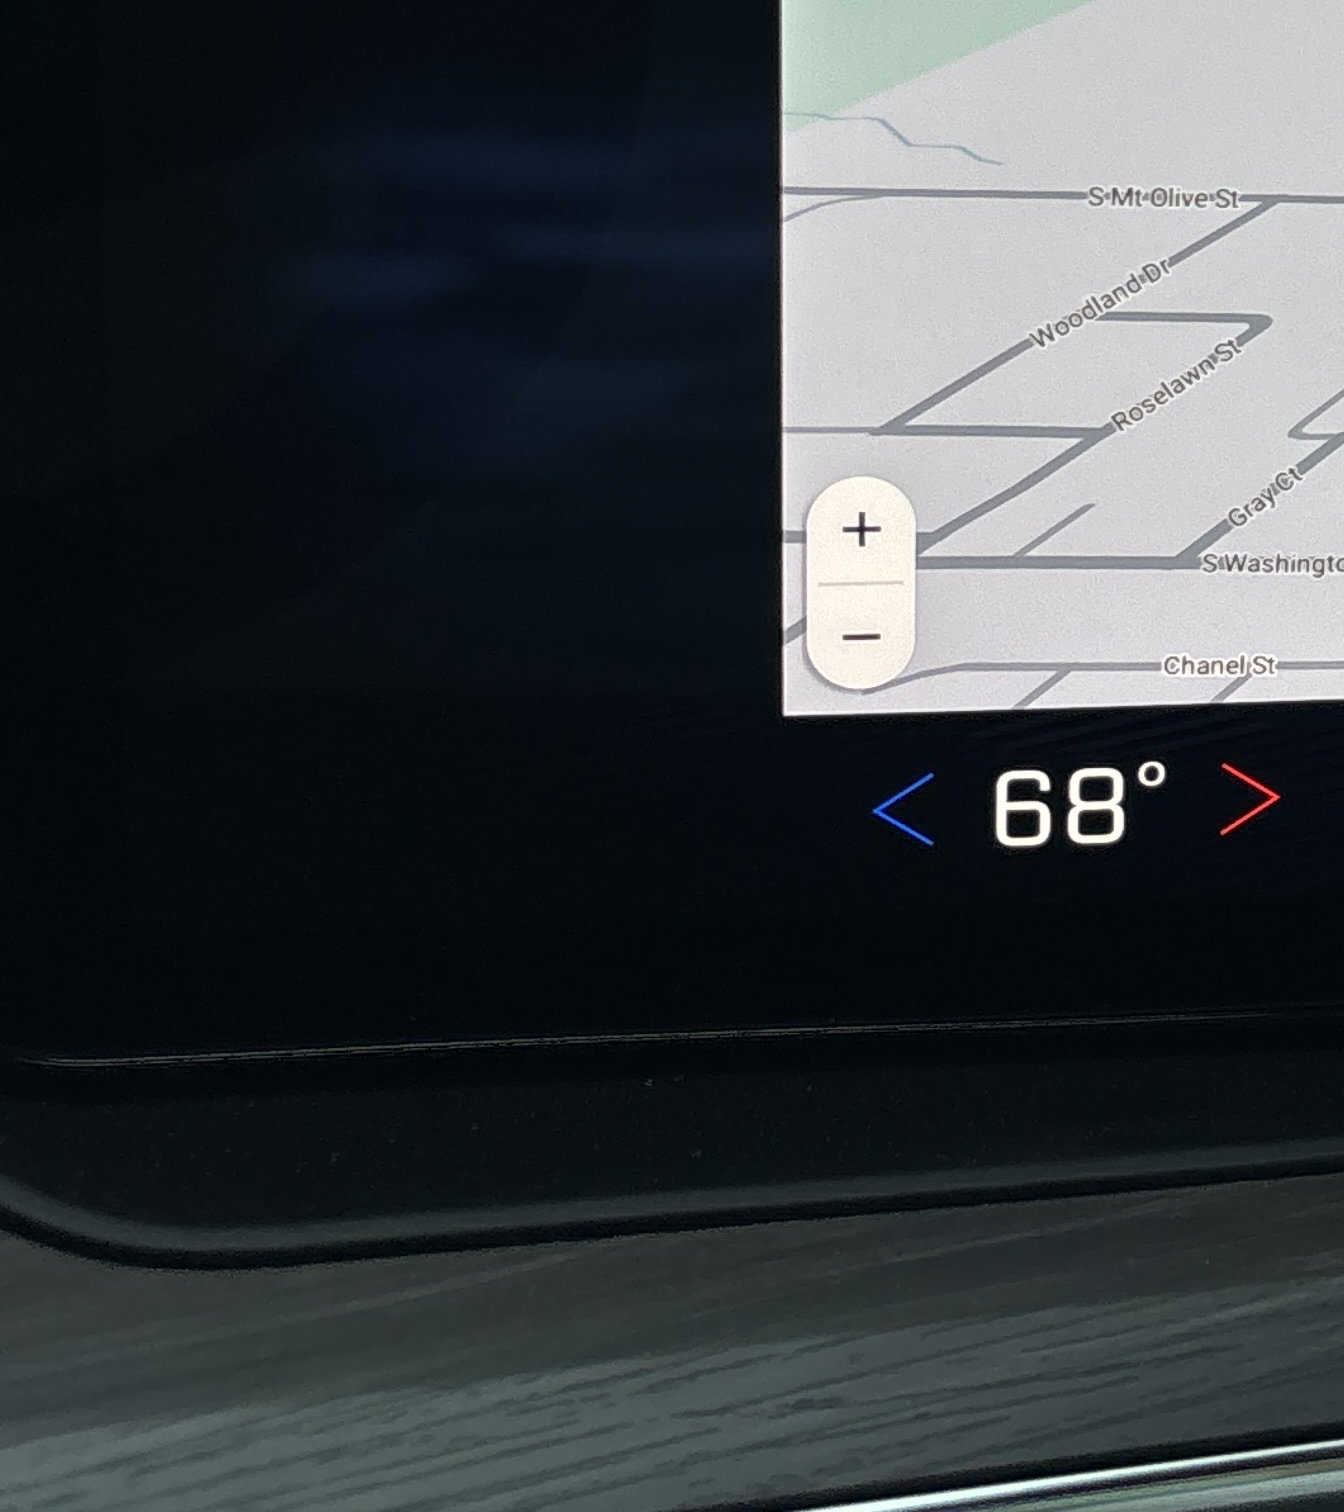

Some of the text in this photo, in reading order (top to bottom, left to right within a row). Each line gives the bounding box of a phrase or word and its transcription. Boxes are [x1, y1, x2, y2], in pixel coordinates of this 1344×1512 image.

[1089, 187, 1240, 211] S Mt Olive St
[1030, 259, 1170, 349] Woodland Dr
[1111, 336, 1242, 432] Roselawn St
[1228, 466, 1303, 530] Gray Ct
[1202, 554, 1218, 572] S
[1163, 655, 1276, 676] Chanel St
[994, 761, 1167, 848] 68°
